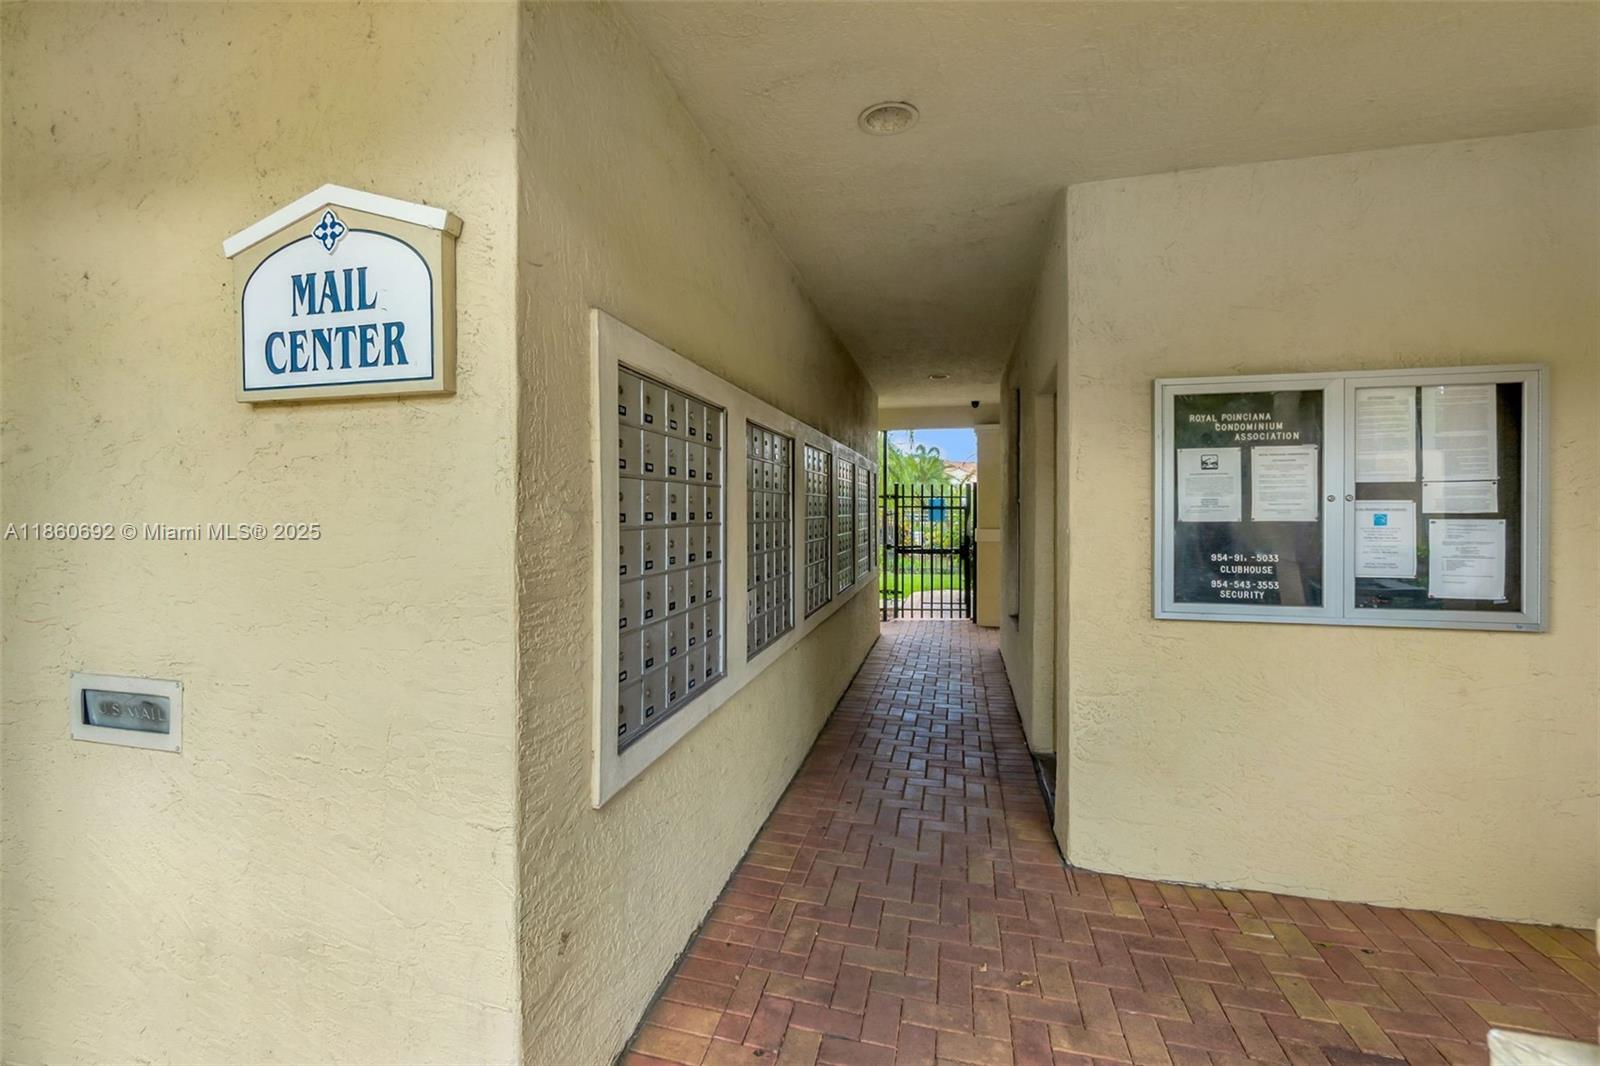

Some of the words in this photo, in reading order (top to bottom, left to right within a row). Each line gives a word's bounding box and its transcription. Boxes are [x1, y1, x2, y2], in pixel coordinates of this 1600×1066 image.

[291, 266, 378, 317] MAIL
[264, 321, 409, 375] CENTER
[1189, 414, 1217, 422] ROYAL
[1221, 413, 1271, 421] POINCIANA
[1215, 422, 1283, 431] CONDOMINIUM
[1234, 432, 1300, 440] ASSOCIATION
[1210, 553, 1280, 562] 954-91-5033
[1220, 565, 1273, 574] CLUBHOUSE
[1210, 580, 1280, 589] 954-543-3553
[1219, 590, 1265, 599] SECURITY
